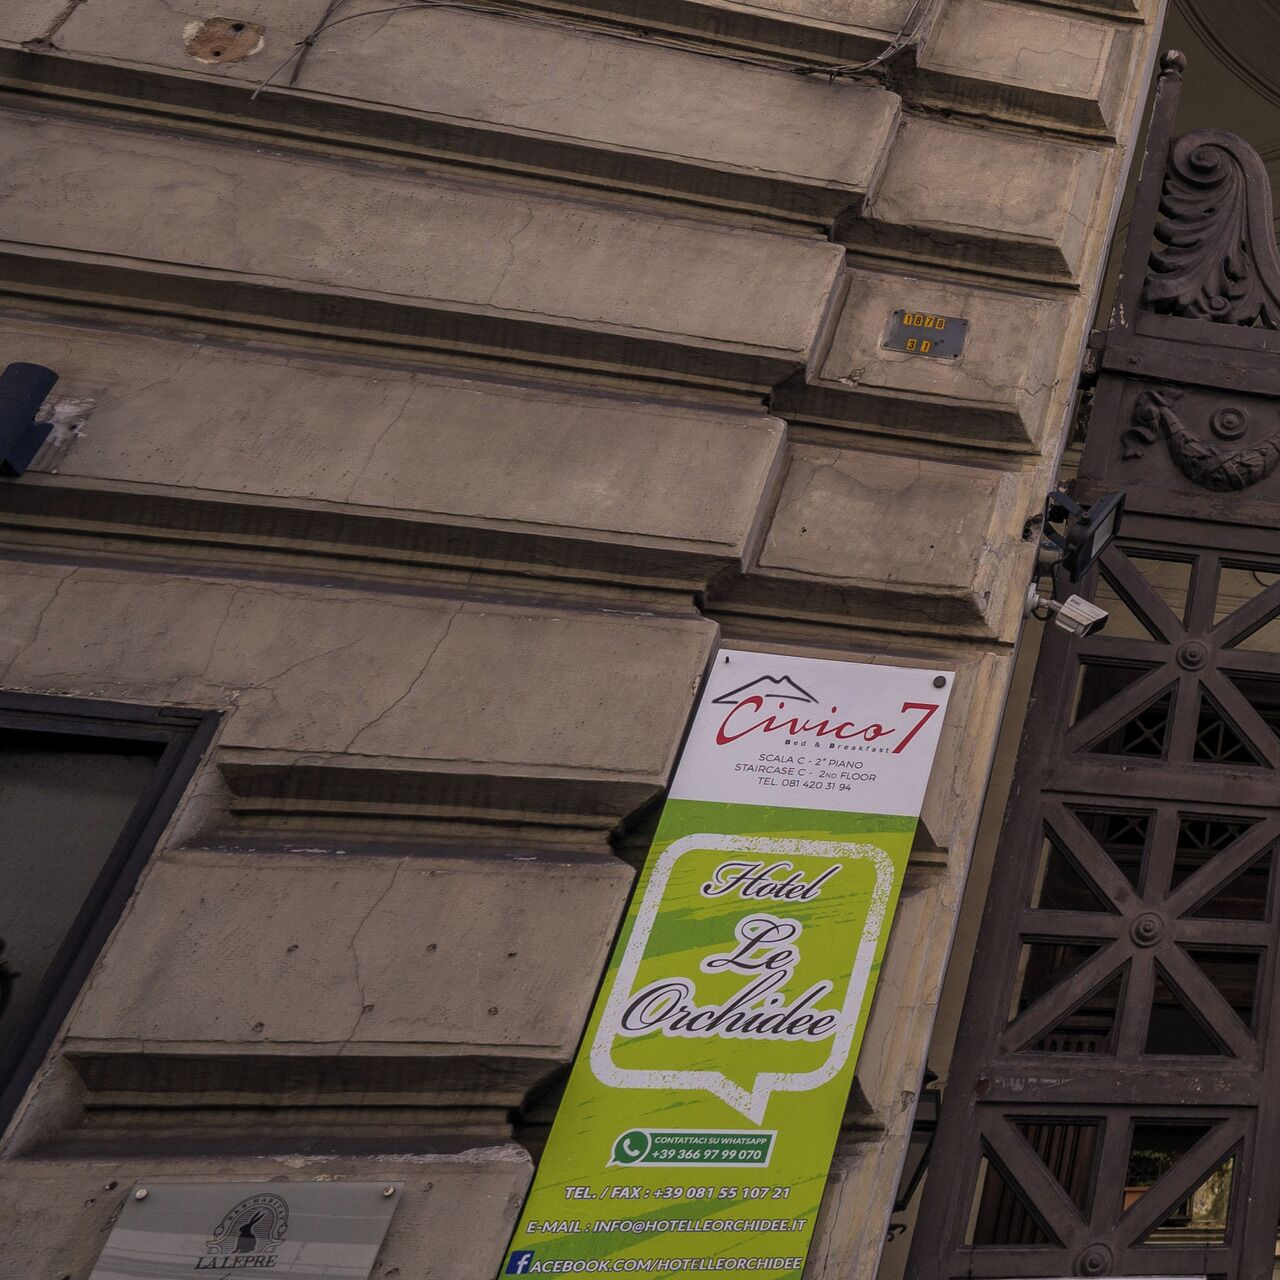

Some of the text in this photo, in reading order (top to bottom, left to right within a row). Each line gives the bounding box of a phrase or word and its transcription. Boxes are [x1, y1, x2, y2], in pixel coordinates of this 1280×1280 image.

[905, 314, 944, 329] 1878
[908, 339, 930, 352] 31
[715, 695, 940, 754] Civico 7
[785, 739, 807, 747] Bed
[829, 743, 890, 754] Breakfast
[758, 753, 795, 765] SCALA
[797, 757, 806, 765] C
[828, 759, 864, 769] PIANO
[734, 763, 795, 776] STAIRCASE
[798, 768, 807, 776] C
[840, 771, 877, 782] FLOOR
[758, 777, 852, 791] TEL. 081 420 31 94
[703, 862, 840, 901] Hotel
[706, 918, 796, 970] Le
[621, 969, 837, 1036] Orchidee
[654, 1136, 768, 1145] CONTATTACI SU WHATSAPP
[652, 1149, 762, 1160] +39 366 97 99 070
[565, 1186, 597, 1200] TEL.
[610, 1186, 642, 1200] FAX
[653, 1186, 683, 1199] +39
[686, 1186, 715, 1199] 081
[718, 1186, 738, 1199] 55
[742, 1186, 770, 1200] 107
[772, 1186, 791, 1200] 21
[526, 1220, 583, 1233] E-MAIL
[593, 1219, 808, 1234] INFO@HOTELLEORCHIDEE.IT
[194, 1255, 279, 1270] LA LEPRE
